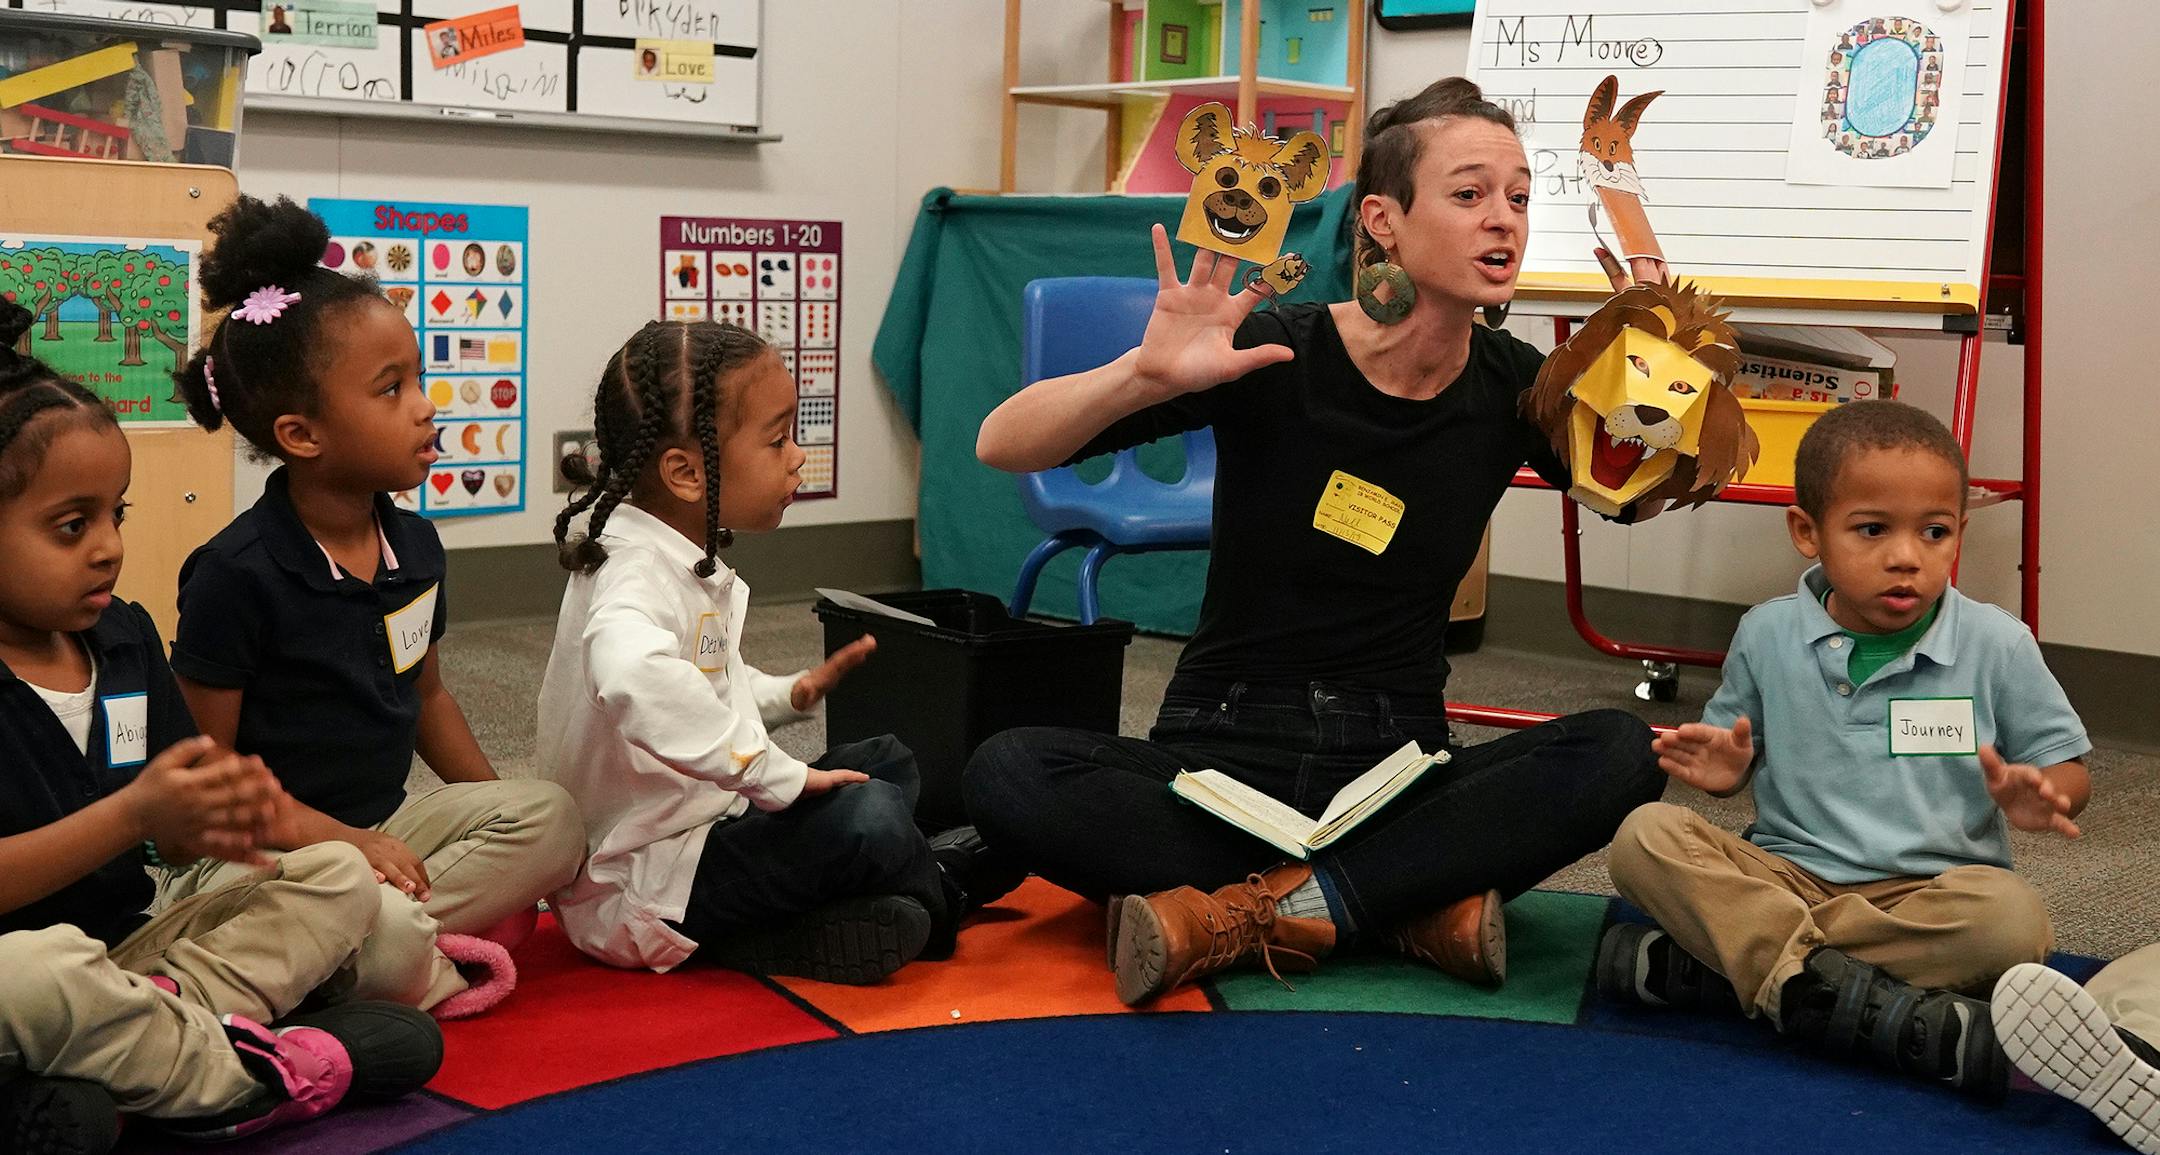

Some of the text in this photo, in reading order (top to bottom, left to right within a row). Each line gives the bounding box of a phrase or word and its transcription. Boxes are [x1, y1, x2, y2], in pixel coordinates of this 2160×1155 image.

[299, 9, 373, 37] Terrian
[459, 22, 516, 52] Miles
[1494, 14, 1649, 67] Ms Moore
[665, 53, 706, 76] Love
[374, 205, 469, 236] Shapes
[681, 221, 823, 248] Numbers 1-20
[88, 372, 100, 382] to
[105, 372, 123, 383] the
[492, 386, 517, 400] STOP
[1348, 503, 1378, 519] VISITOR
[1378, 515, 1396, 529] PASS
[402, 619, 430, 650] Love
[115, 721, 147, 748] Abig
[1899, 718, 1963, 743] Journey
